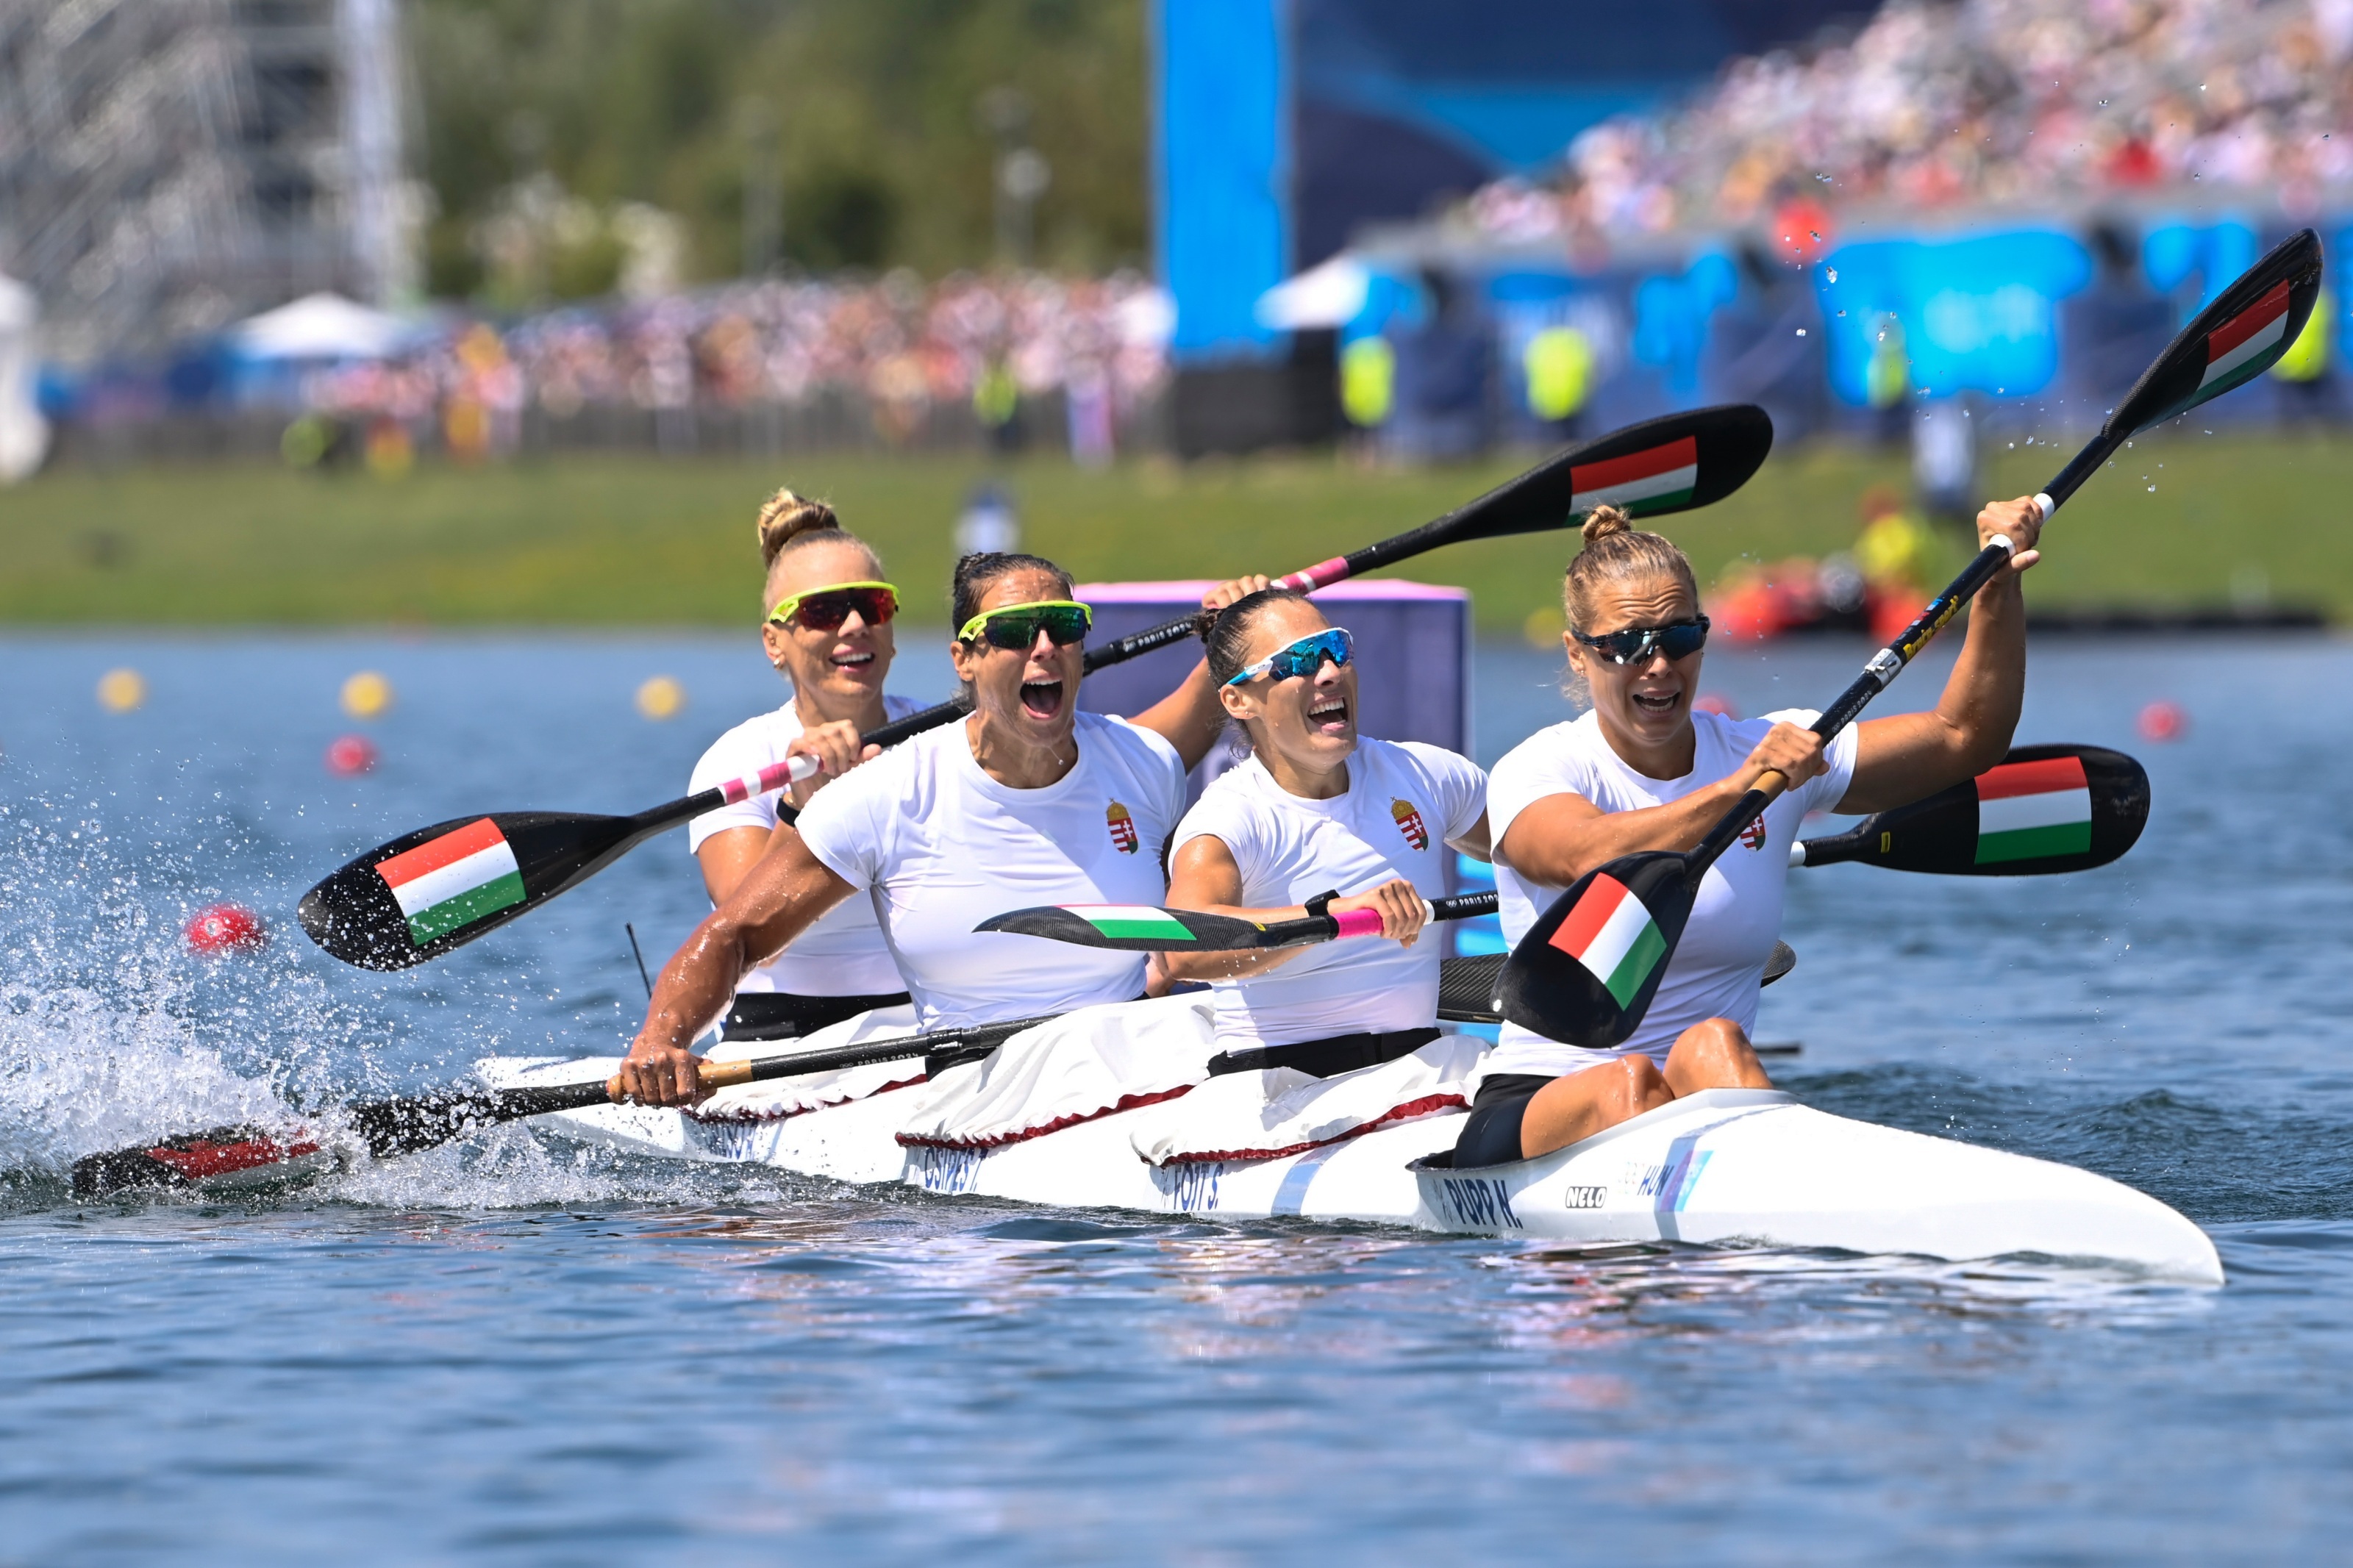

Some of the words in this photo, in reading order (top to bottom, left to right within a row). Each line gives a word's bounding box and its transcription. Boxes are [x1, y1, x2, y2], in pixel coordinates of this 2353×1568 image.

[1138, 630, 1165, 647] PARIS
[1166, 621, 1191, 637] 2024
[1840, 705, 1857, 725] PARIS
[1857, 690, 1872, 709] 2024
[1459, 896, 1482, 907] PARIS
[857, 1057, 888, 1067] PARIS
[890, 1052, 919, 1062] 2024
[1174, 1162, 1210, 1211] FOJT
[1637, 1165, 1675, 1196] HUN
[1443, 1178, 1497, 1226] PUPP
[1493, 1179, 1524, 1230] N.
[1565, 1186, 1607, 1209] NELO
